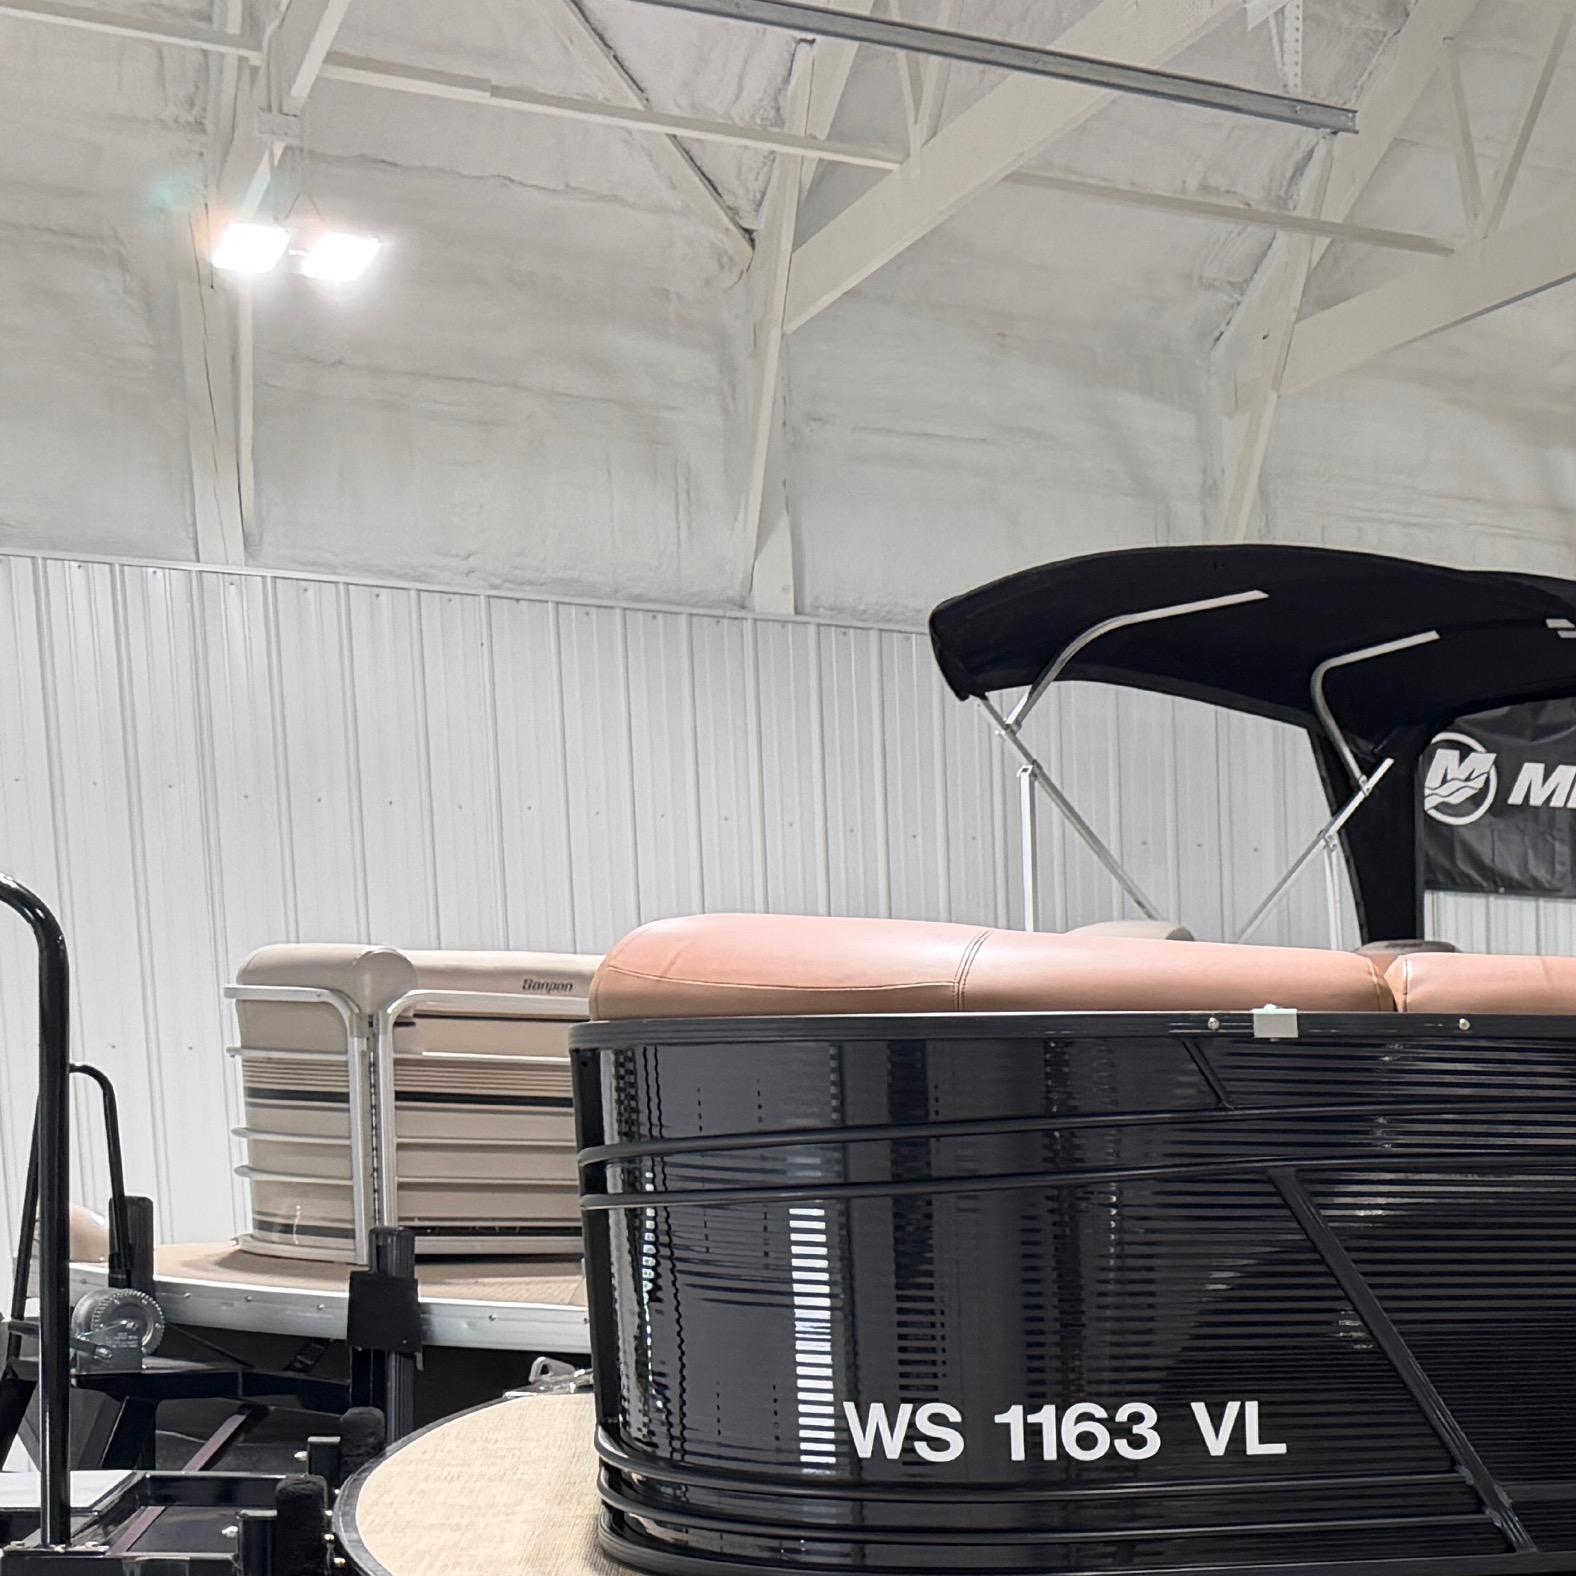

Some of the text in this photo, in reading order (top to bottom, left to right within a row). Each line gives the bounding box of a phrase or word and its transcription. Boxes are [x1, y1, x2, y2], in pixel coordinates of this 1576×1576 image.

[842, 1399, 1288, 1463] WS 1163 VL
